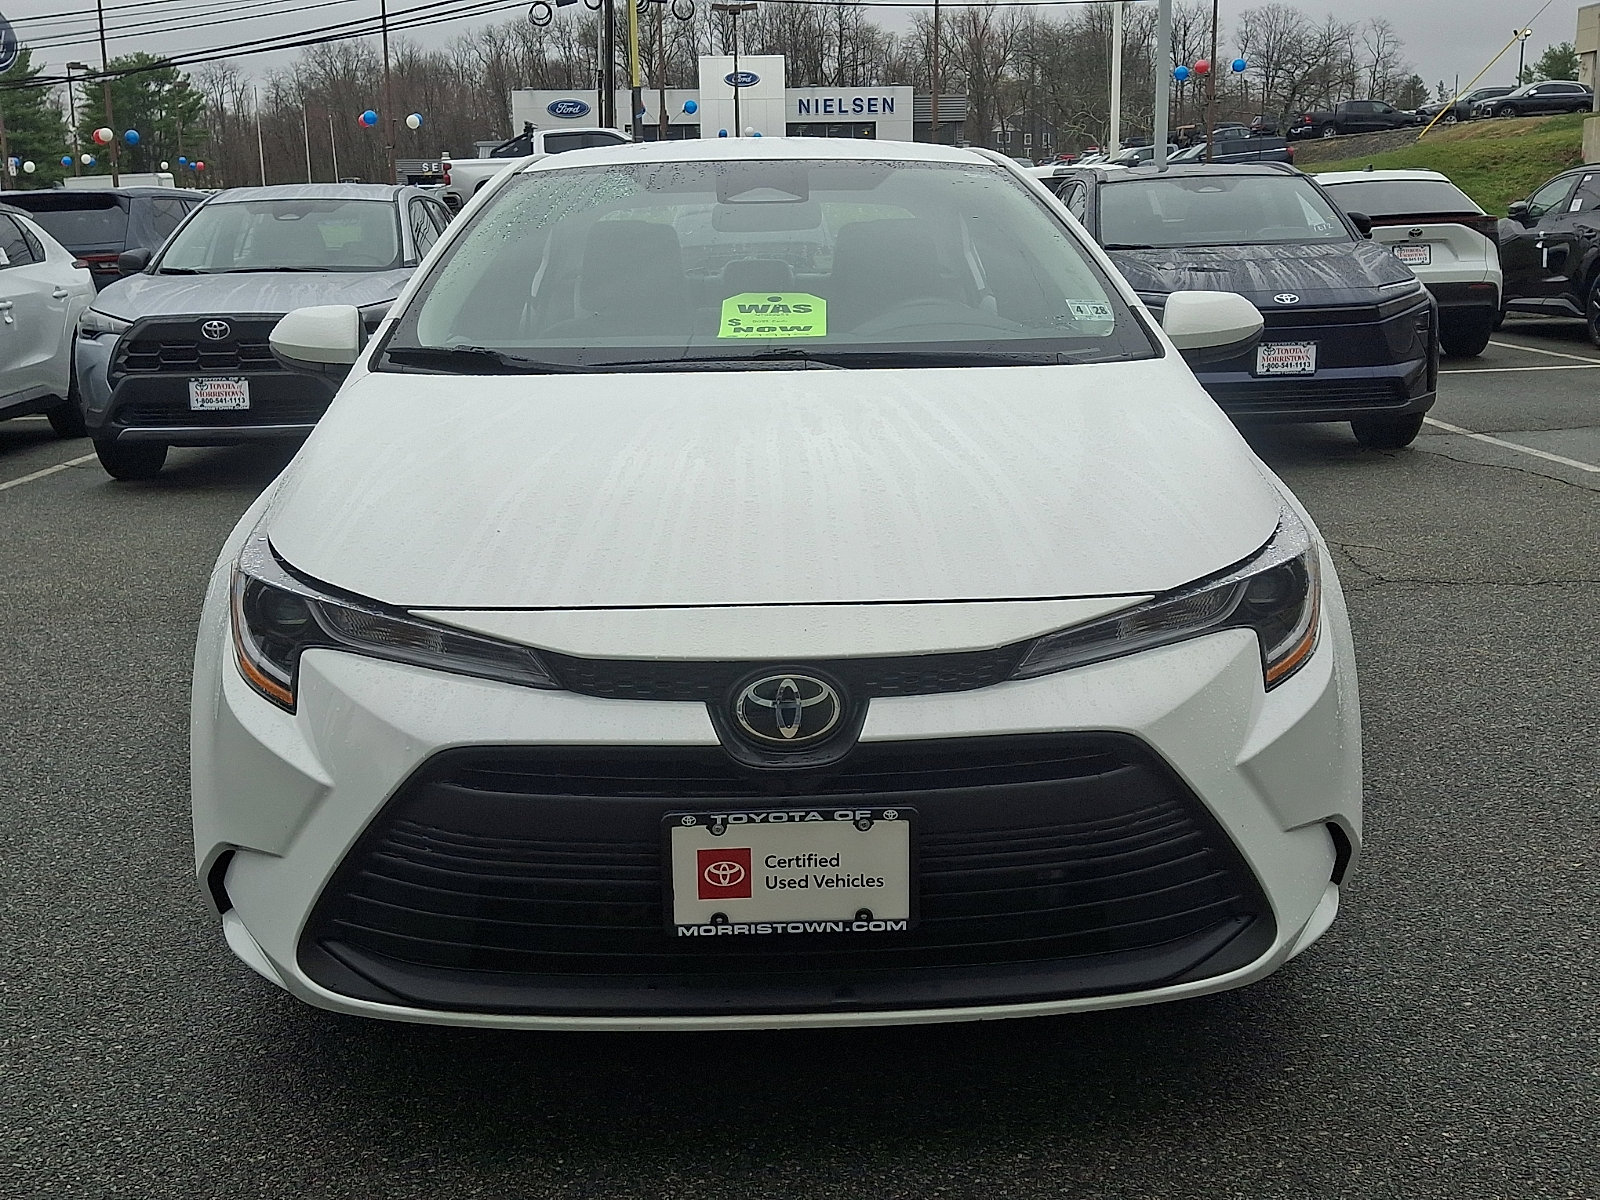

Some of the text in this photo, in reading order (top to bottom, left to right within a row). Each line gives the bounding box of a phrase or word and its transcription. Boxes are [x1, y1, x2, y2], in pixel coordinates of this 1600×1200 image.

[556, 102, 580, 114] Ford
[798, 97, 895, 114] NIELSEN
[737, 304, 813, 314] WAS
[1076, 305, 1108, 315] 4 28
[733, 325, 813, 333] NOW
[1261, 355, 1311, 363] MORRISTOWN
[710, 810, 872, 825] TOYOTA OF
[764, 853, 840, 869] Certified
[765, 873, 884, 889] Used Vehicles
[677, 921, 907, 937] MORRISTOWN.COM
